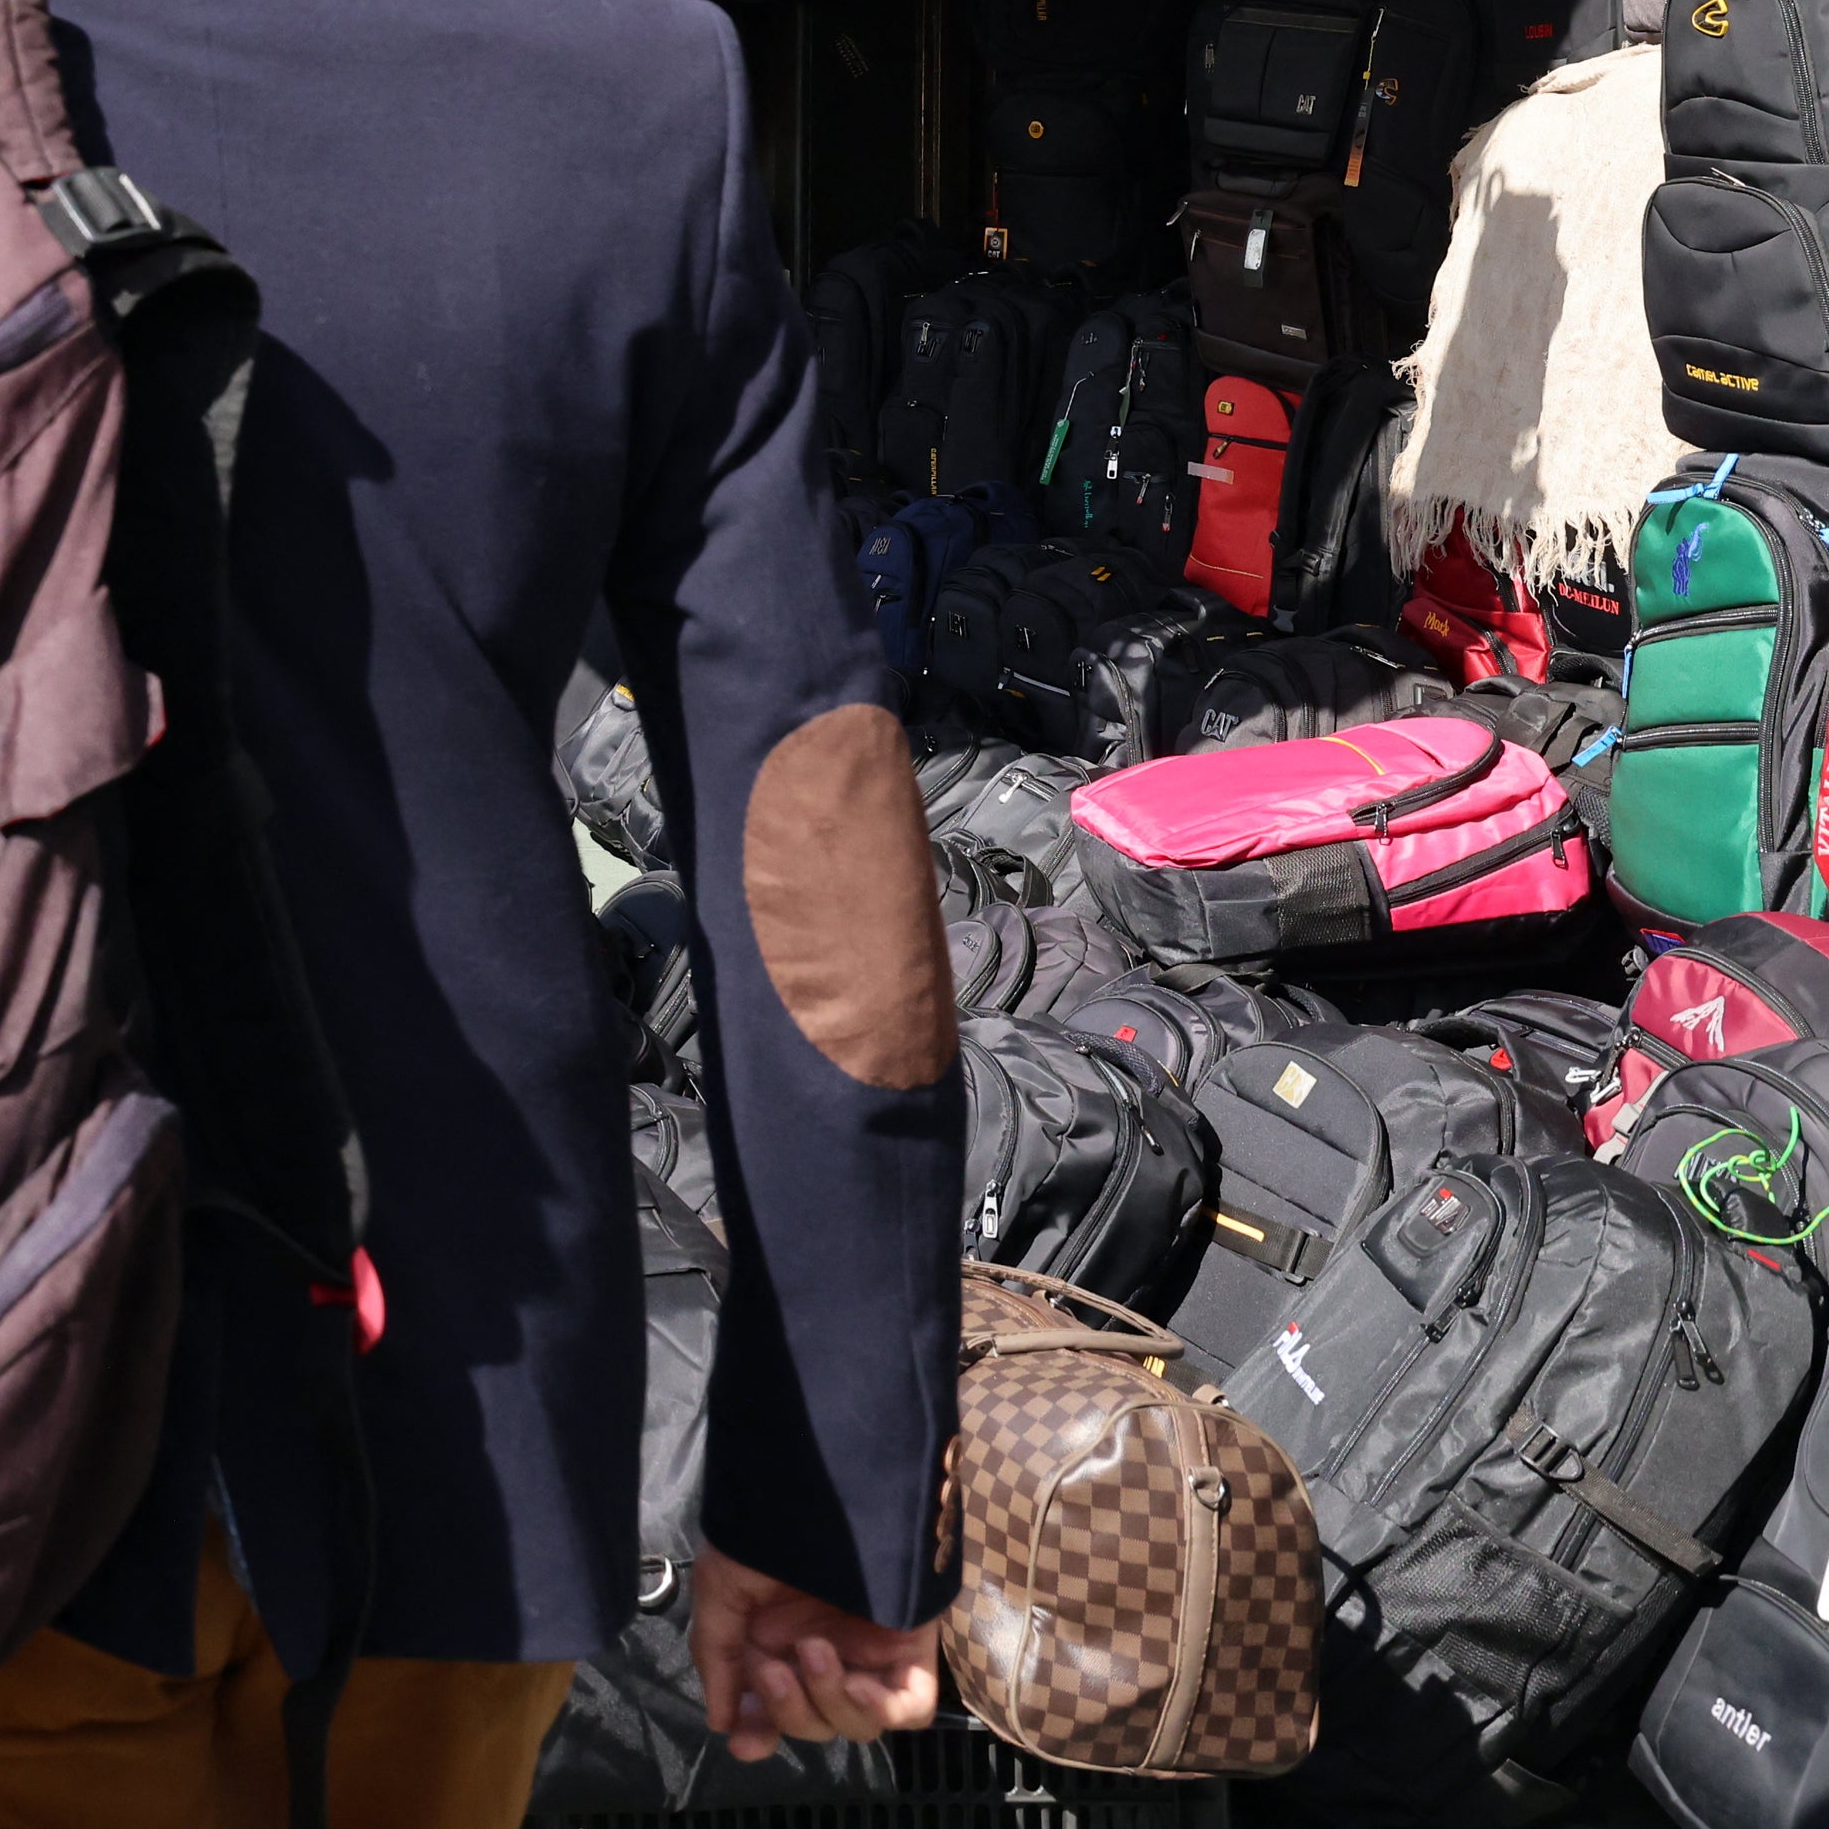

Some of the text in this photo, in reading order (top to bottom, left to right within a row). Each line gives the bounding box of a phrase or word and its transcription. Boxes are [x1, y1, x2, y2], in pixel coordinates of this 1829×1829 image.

[1296, 94, 1316, 116] CAT
[1201, 708, 1241, 743] CAT
[1710, 1695, 1772, 1755] antler
